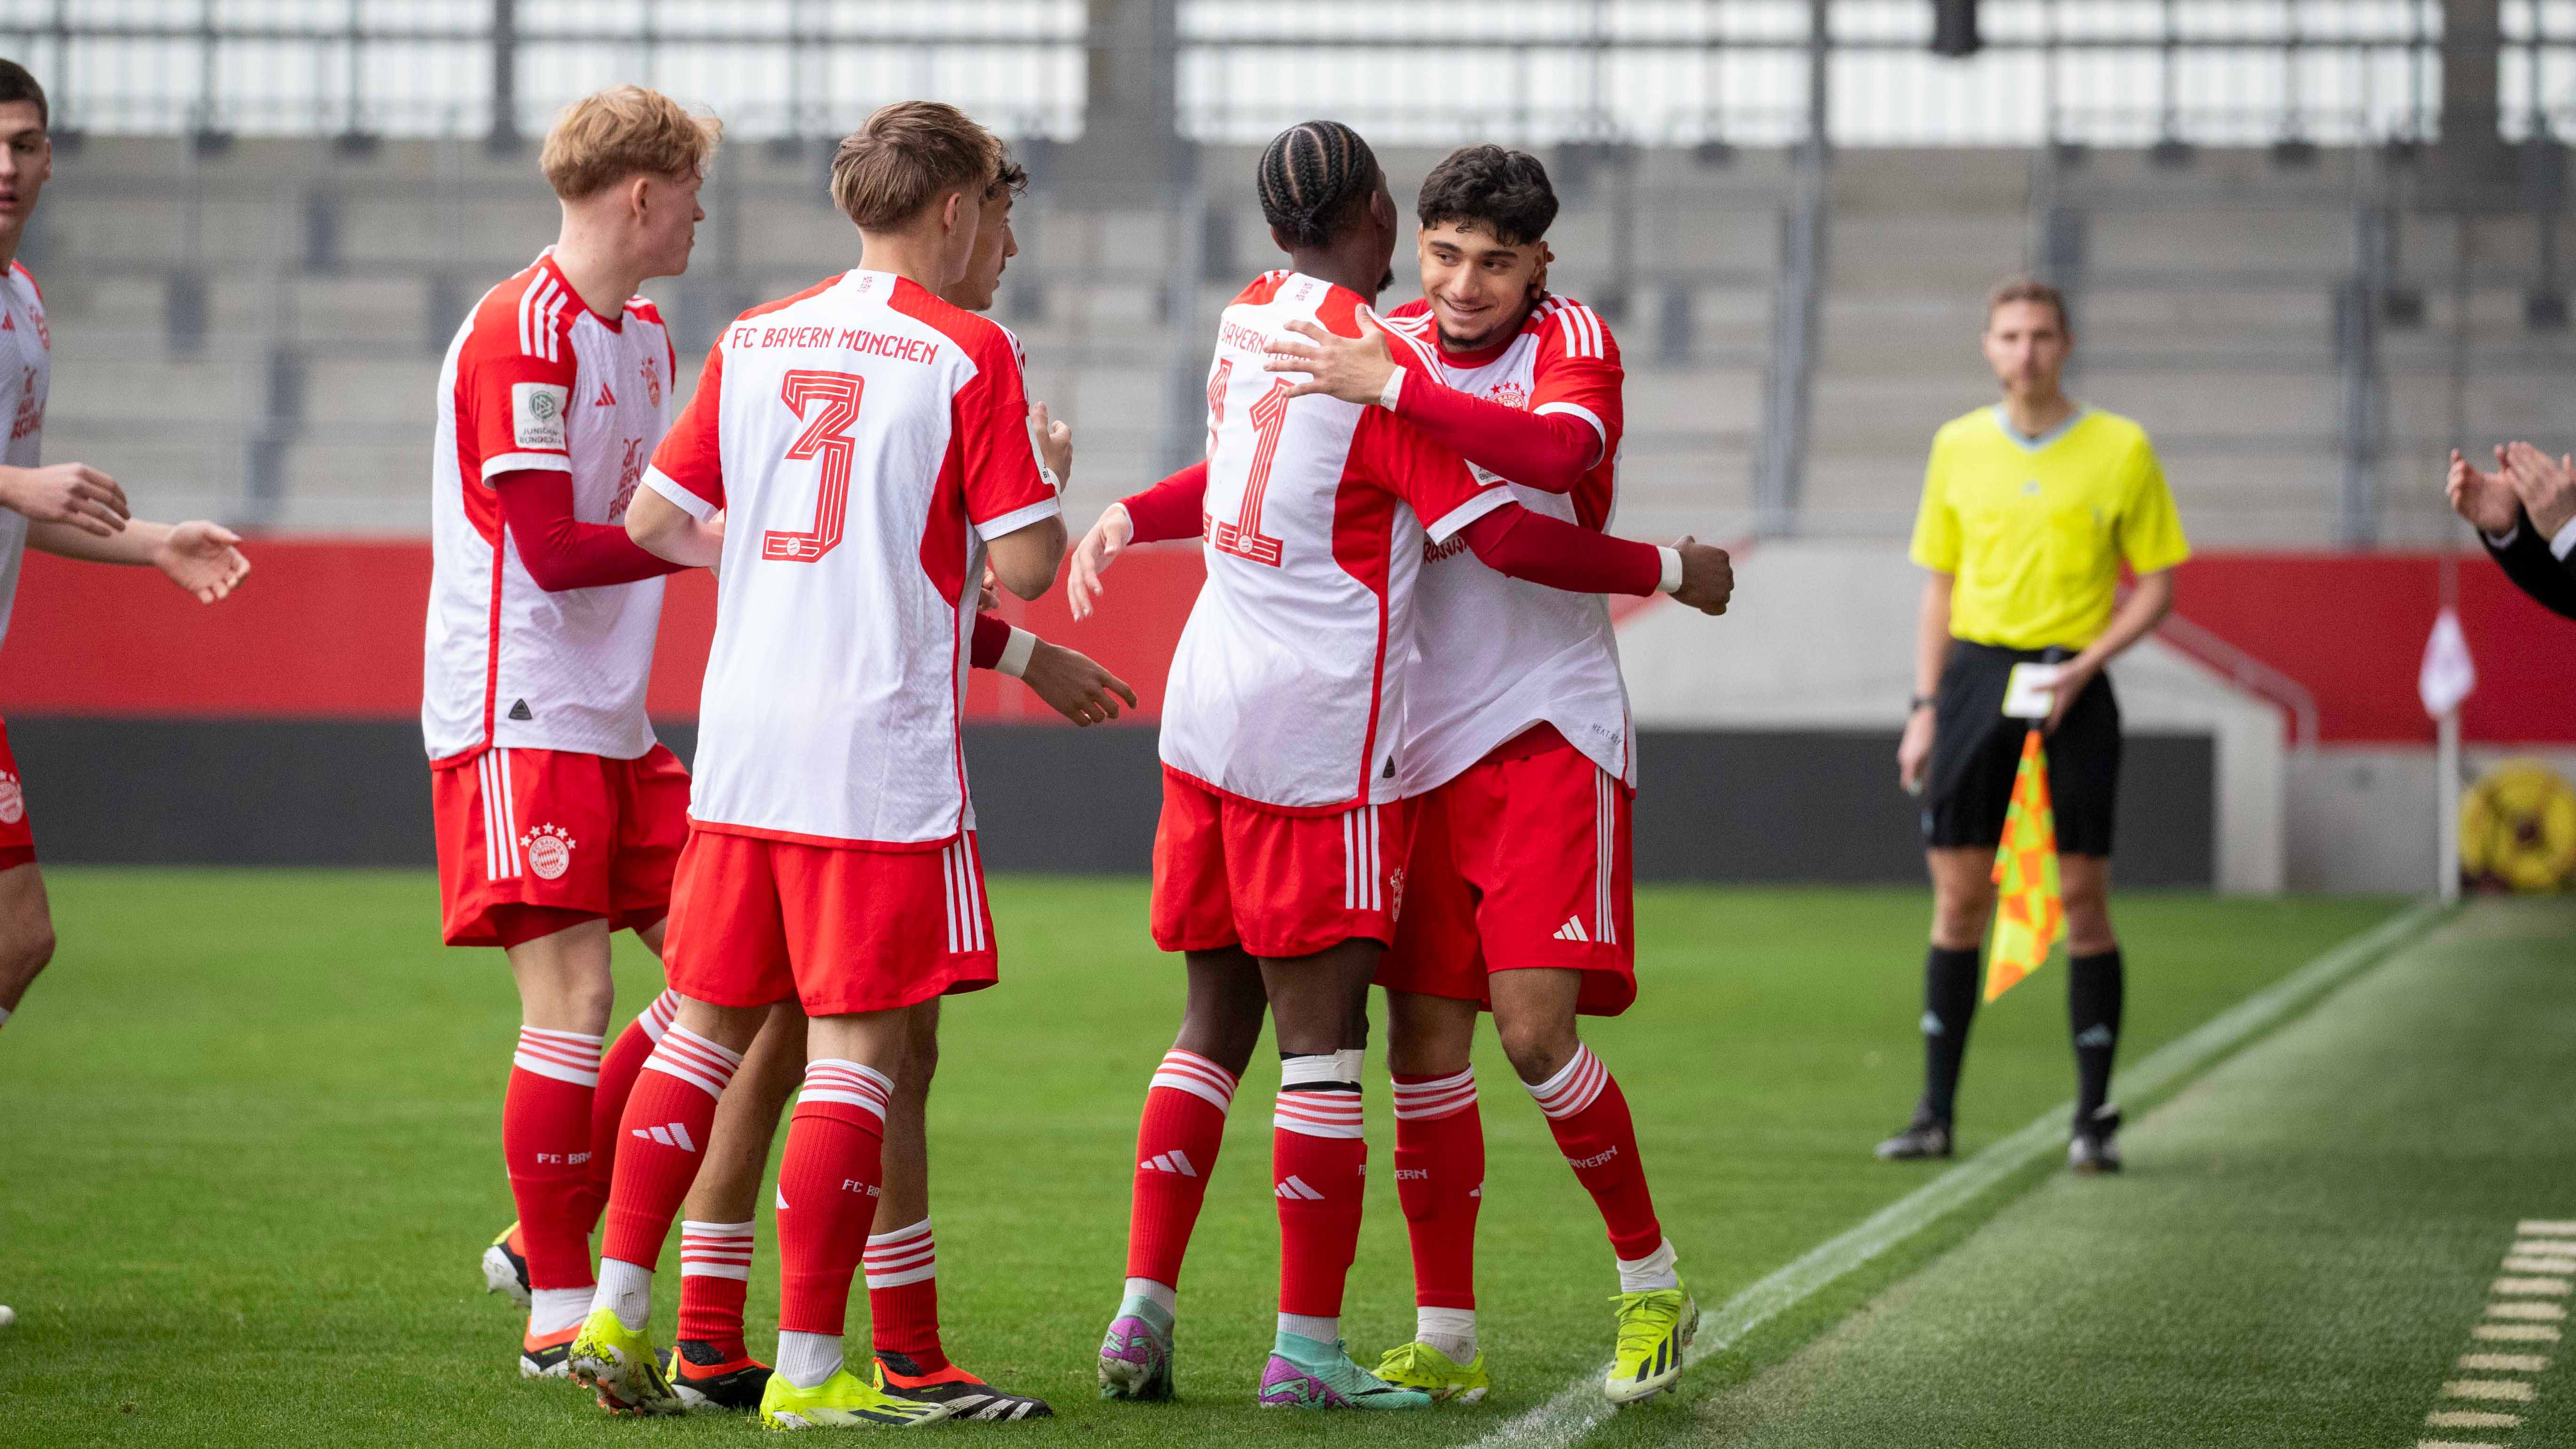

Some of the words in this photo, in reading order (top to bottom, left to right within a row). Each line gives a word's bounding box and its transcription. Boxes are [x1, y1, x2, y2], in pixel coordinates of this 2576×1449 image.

[733, 328, 757, 348] FC
[761, 327, 834, 347] BAYERN
[837, 328, 939, 365] MÜNCHEN
[537, 1153, 562, 1164] FC
[842, 1179, 863, 1192] FC
